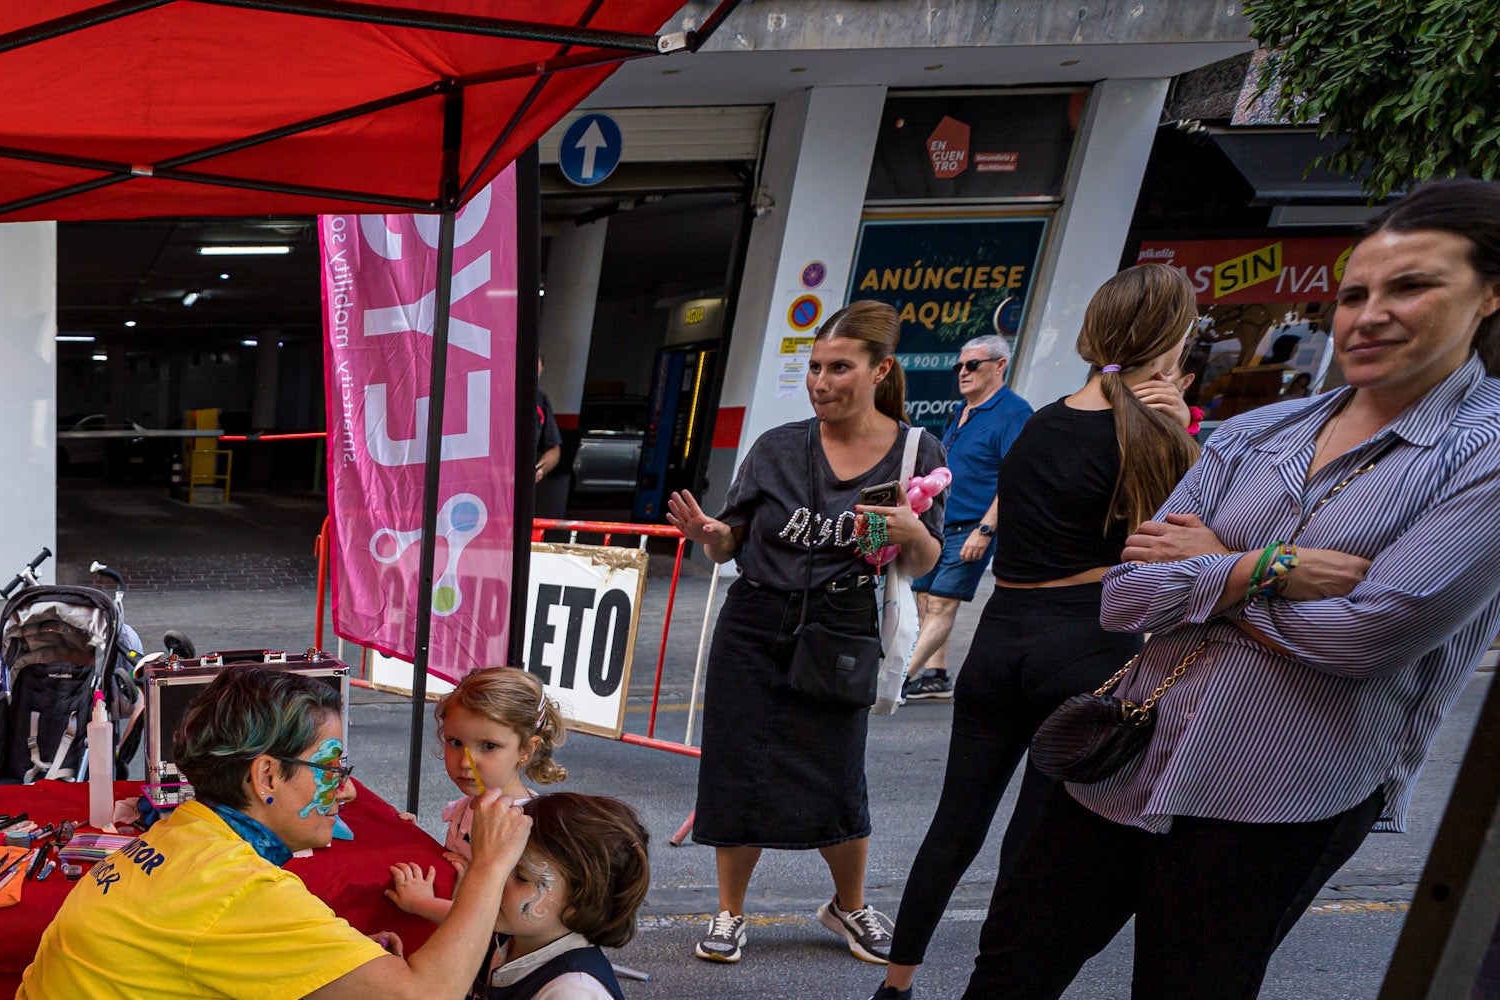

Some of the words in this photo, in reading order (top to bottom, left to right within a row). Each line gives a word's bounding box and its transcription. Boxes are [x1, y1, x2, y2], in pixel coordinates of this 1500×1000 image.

[932, 151, 965, 161] CUEN
[860, 259, 1026, 291] ANÚNCIESE
[1219, 246, 1276, 292] SIN
[1275, 265, 1329, 294] IVA
[900, 293, 976, 330] AQUÍ
[913, 356, 940, 368] 900
